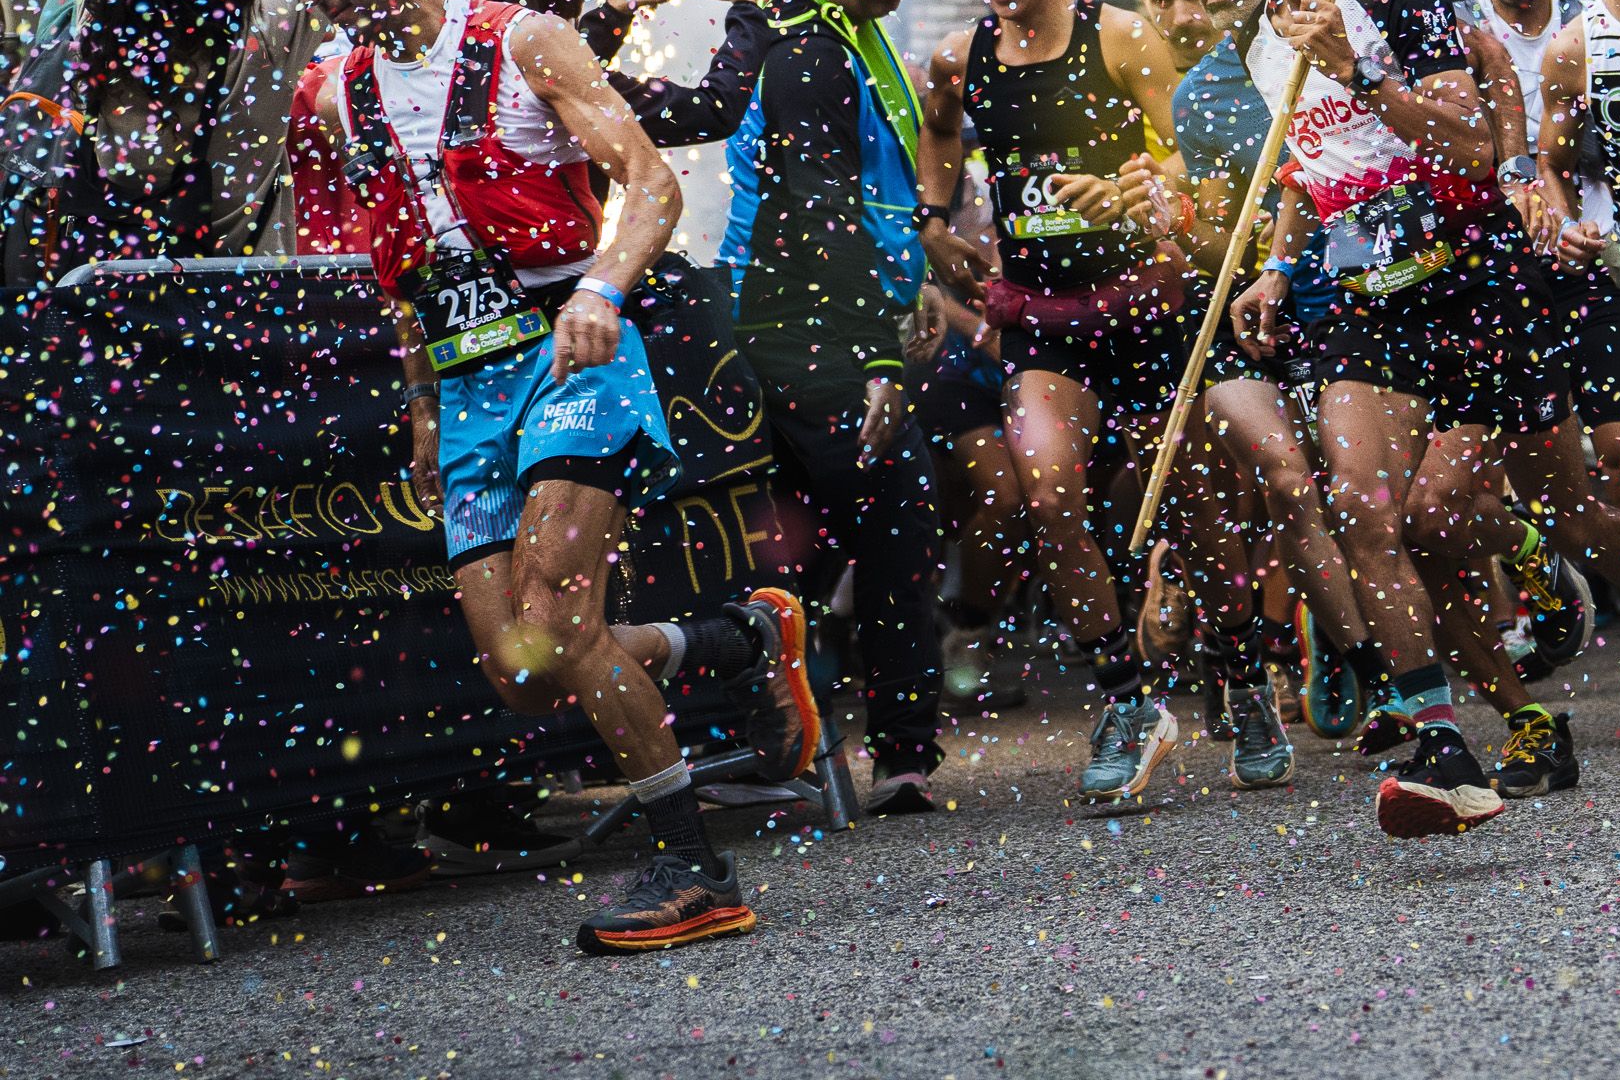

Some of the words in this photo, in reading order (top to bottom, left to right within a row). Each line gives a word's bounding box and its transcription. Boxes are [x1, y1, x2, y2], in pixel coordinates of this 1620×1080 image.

[1372, 222, 1393, 258] 4
[1375, 256, 1394, 268] ZAID
[1383, 270, 1403, 281] Soria
[1402, 265, 1418, 276] puro
[438, 276, 509, 328] 273
[543, 398, 597, 420] RECTA
[549, 413, 596, 434] FINAL
